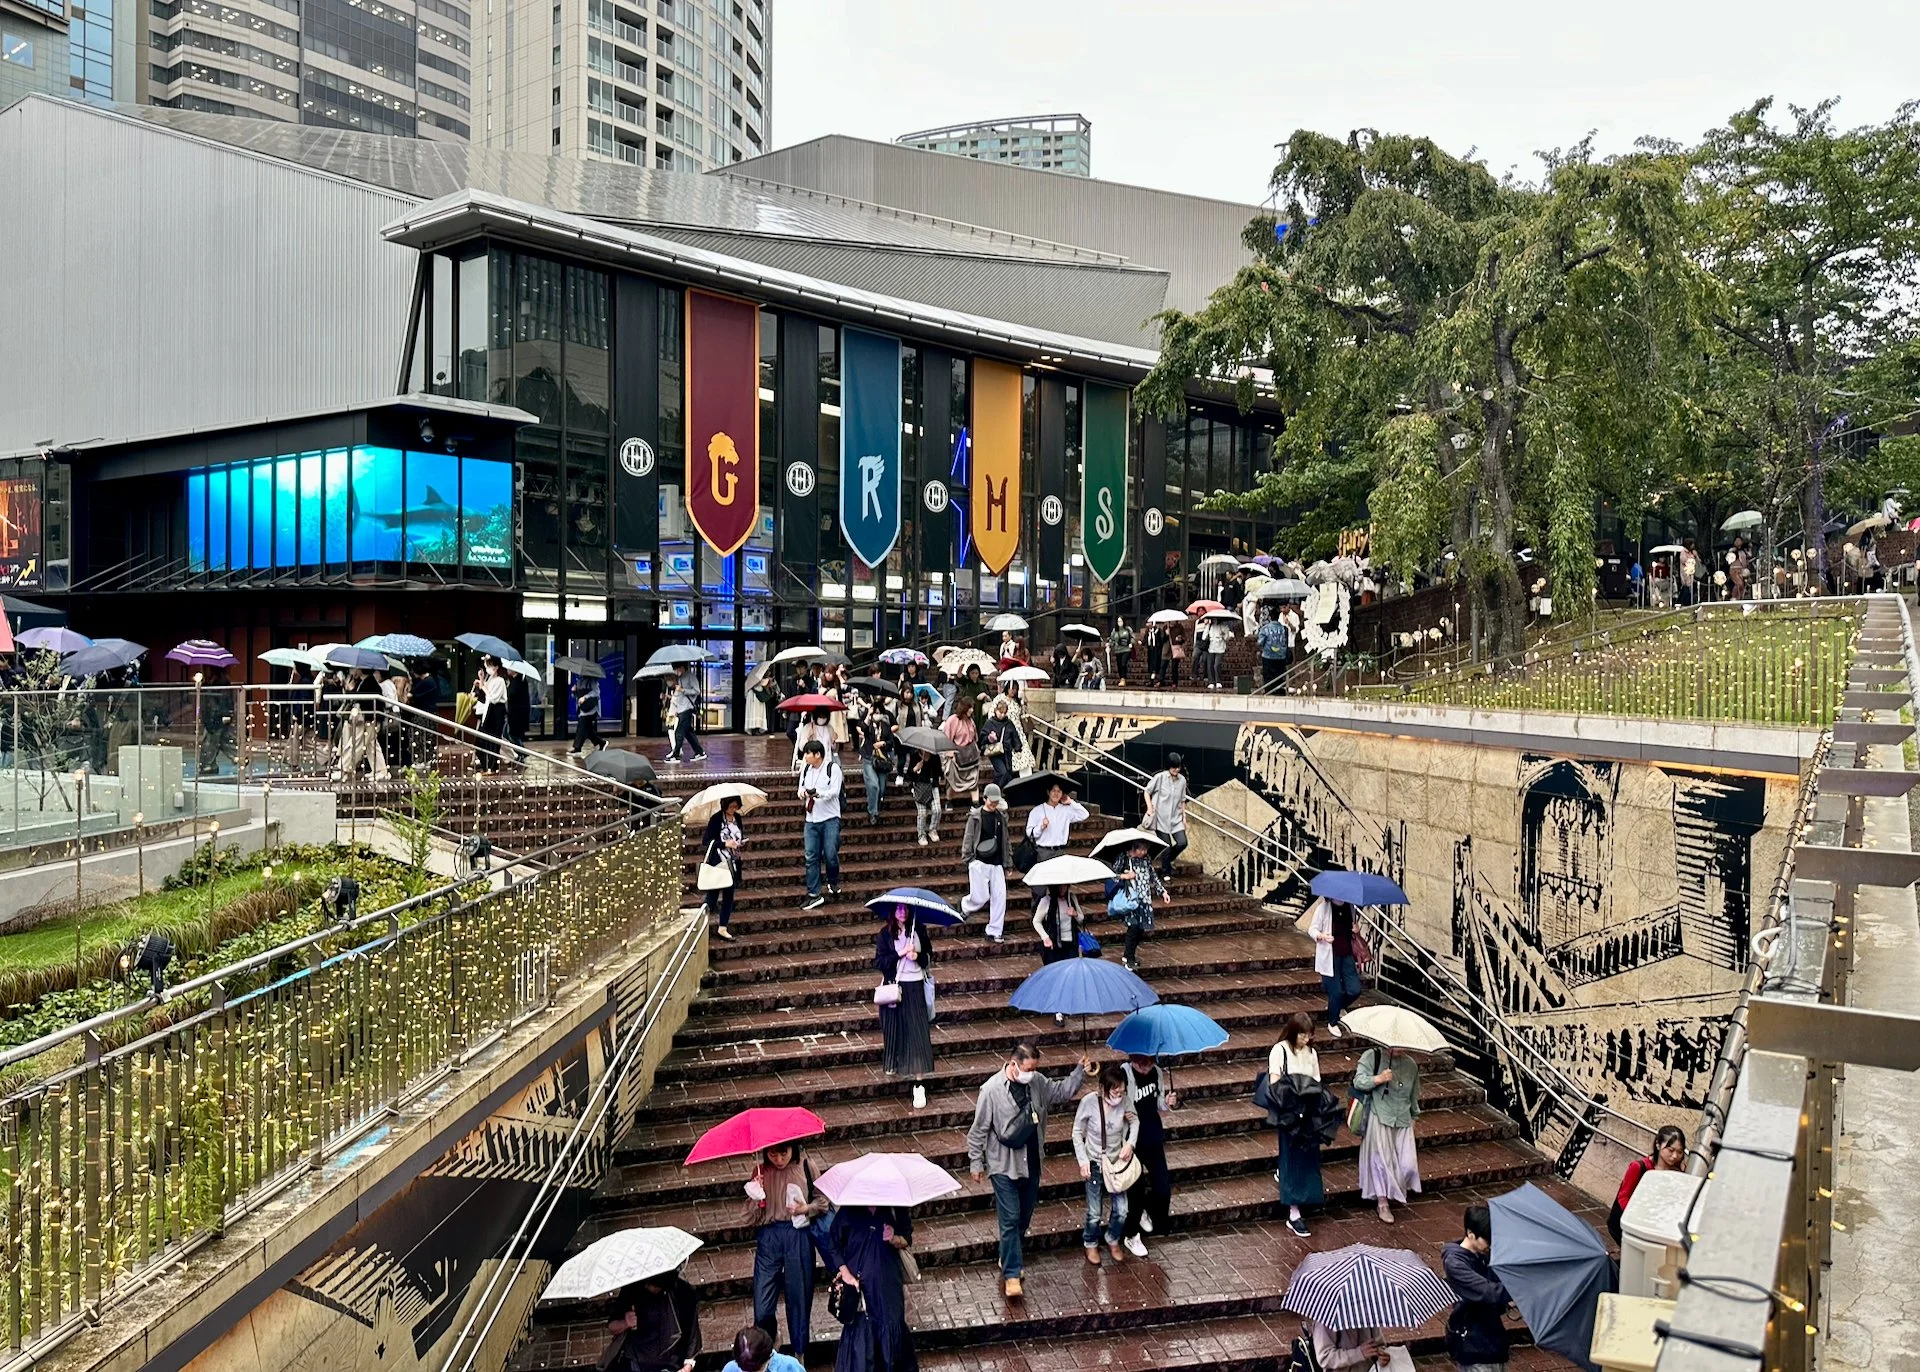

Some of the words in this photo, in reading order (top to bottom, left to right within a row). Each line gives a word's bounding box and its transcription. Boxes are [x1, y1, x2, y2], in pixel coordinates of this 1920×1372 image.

[858, 455, 885, 523] R
[986, 474, 1008, 533] H
[1095, 487, 1114, 544] S
